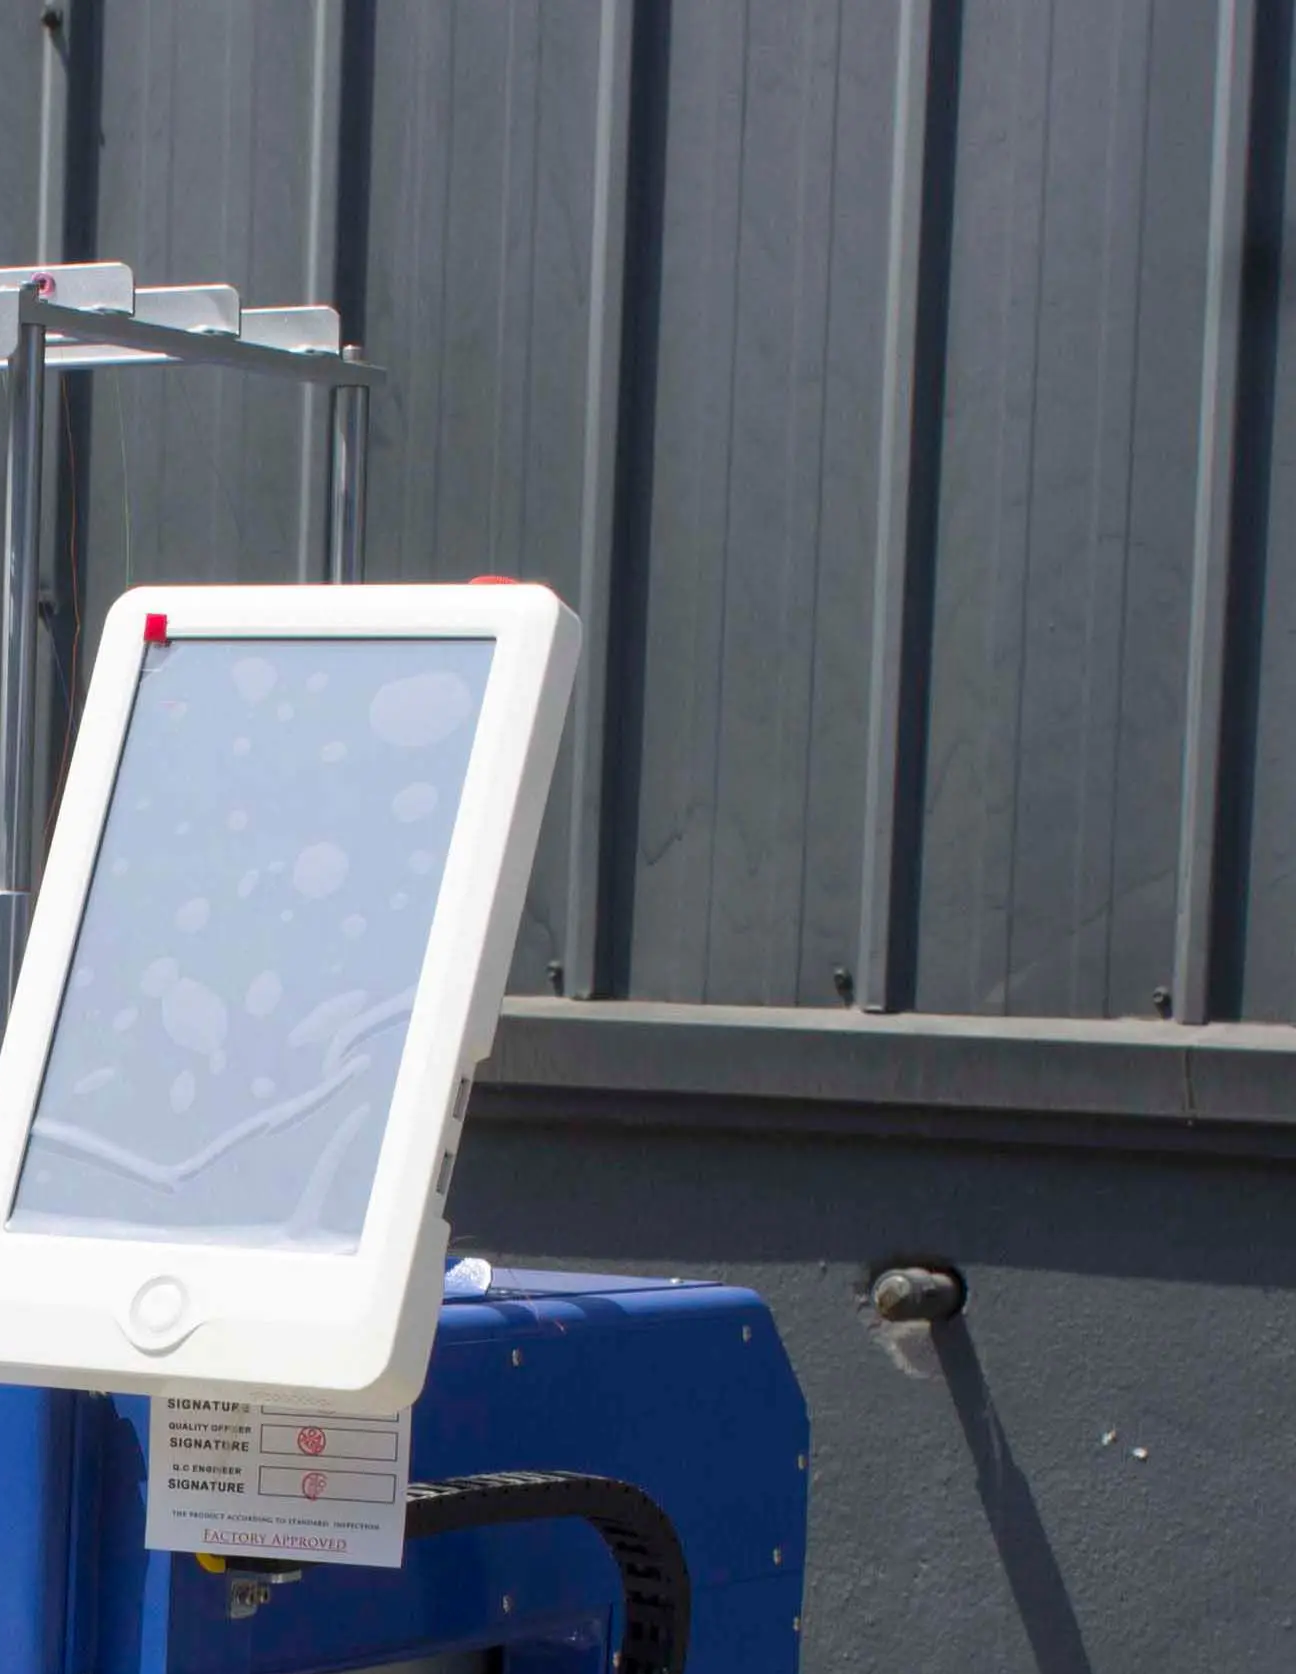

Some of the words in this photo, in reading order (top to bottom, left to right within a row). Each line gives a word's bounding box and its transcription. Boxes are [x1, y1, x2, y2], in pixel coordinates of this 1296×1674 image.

[168, 1422, 208, 1432] QUALITY
[169, 1437, 249, 1452] SIGNATURE
[168, 1478, 245, 1493] SIGNATURE
[172, 1510, 187, 1518] THE
[189, 1512, 225, 1520] PRODUCT
[226, 1514, 273, 1524] ACCORDING
[275, 1517, 286, 1525] TO
[334, 1521, 380, 1530] INSPECTION
